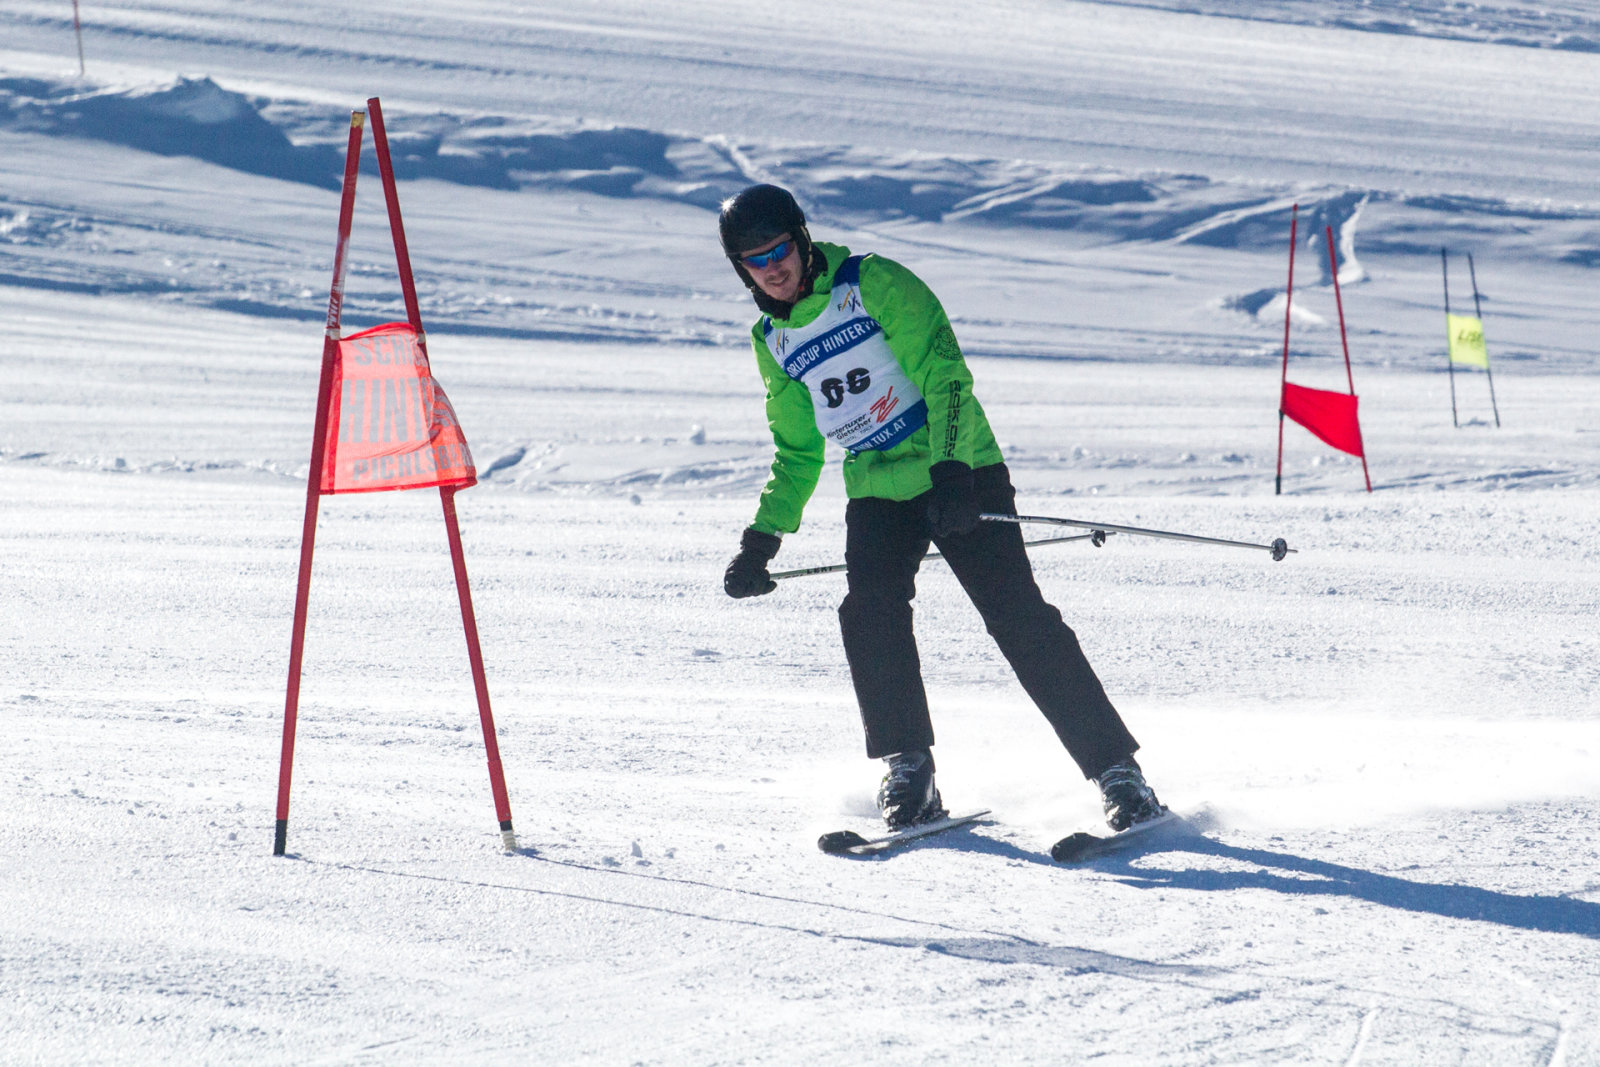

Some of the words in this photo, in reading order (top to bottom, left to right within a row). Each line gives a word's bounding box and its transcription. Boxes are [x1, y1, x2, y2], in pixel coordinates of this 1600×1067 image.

[786, 344, 820, 378] ORLDCUP
[826, 413, 867, 439] Hintertuxer
[836, 417, 872, 440] Gletscher
